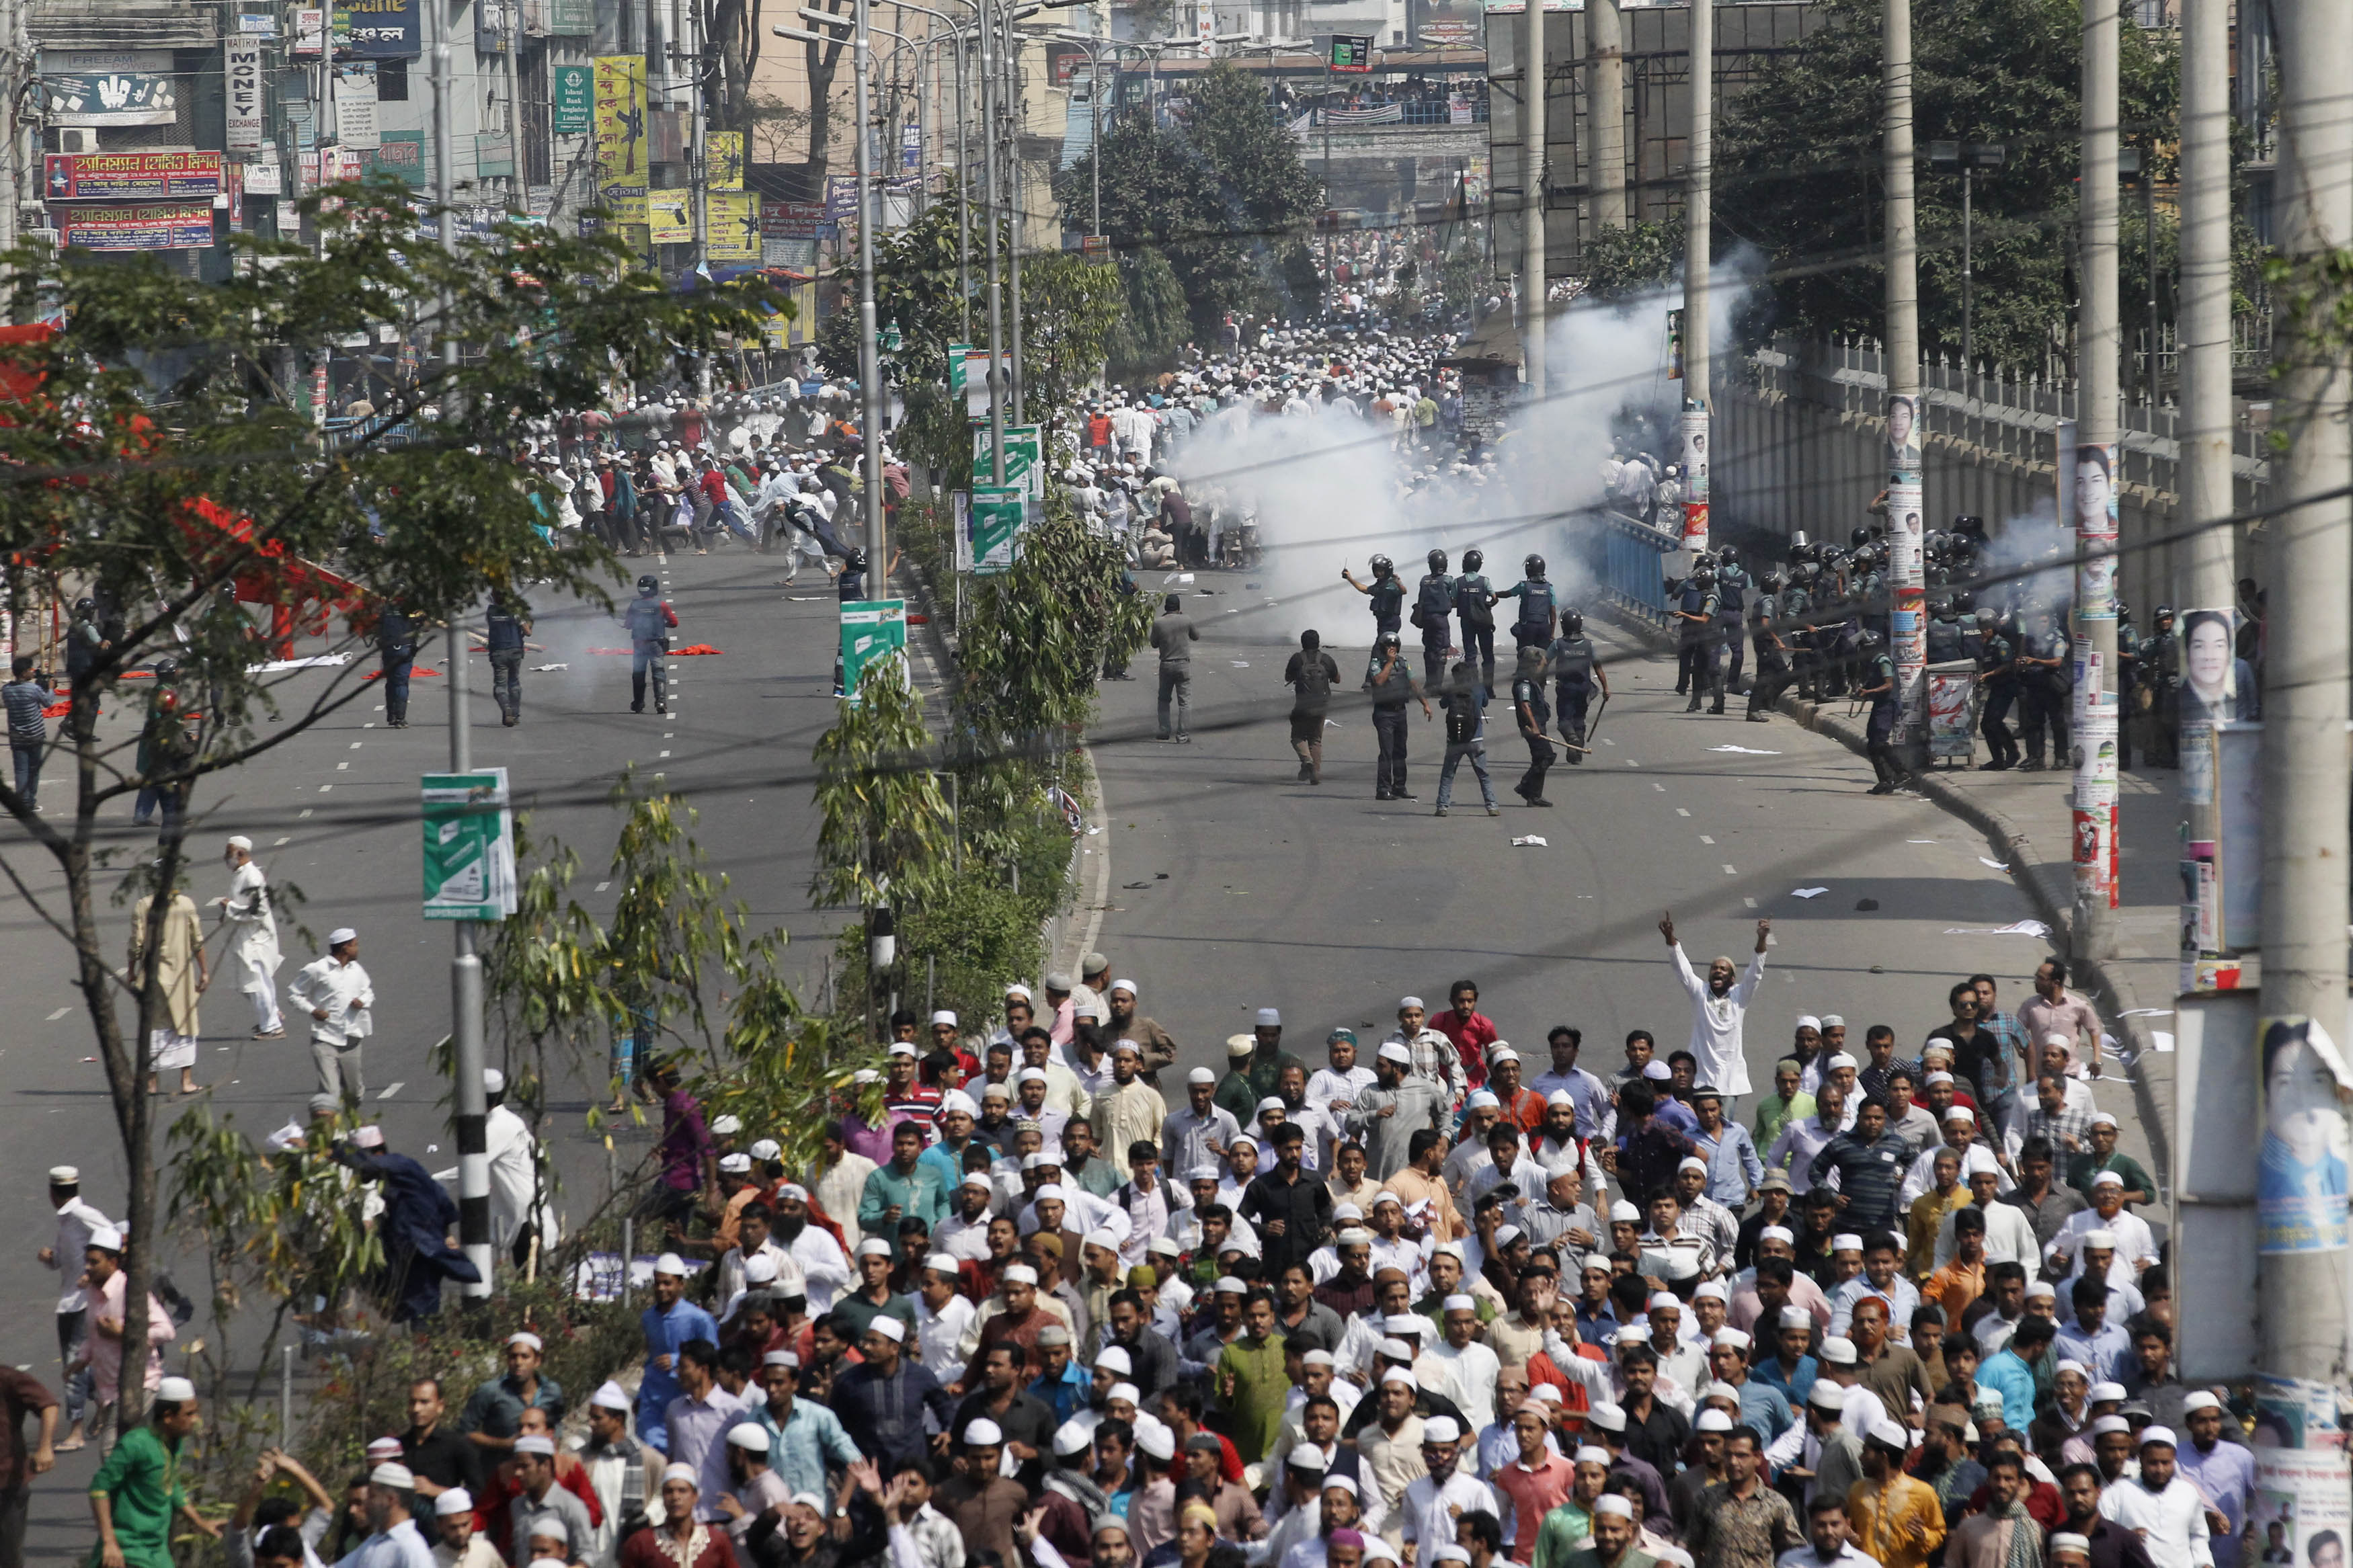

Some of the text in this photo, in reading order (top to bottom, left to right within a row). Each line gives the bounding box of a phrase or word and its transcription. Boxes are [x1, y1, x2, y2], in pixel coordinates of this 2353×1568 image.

[227, 38, 260, 48] MATTRIK
[73, 55, 132, 64] FREEAM
[112, 62, 157, 71] POWER
[231, 52, 255, 116] MONEY
[228, 119, 260, 128] EXCHANGE
[378, 139, 420, 166] বাজার
[75, 153, 218, 171] হ্যানিম্যান হোমিও মিশন
[607, 187, 645, 196] দোতলা
[70, 205, 210, 222] হ্যানিম্যান হোমিও মিশন
[1722, 579, 1742, 587] PLICE
